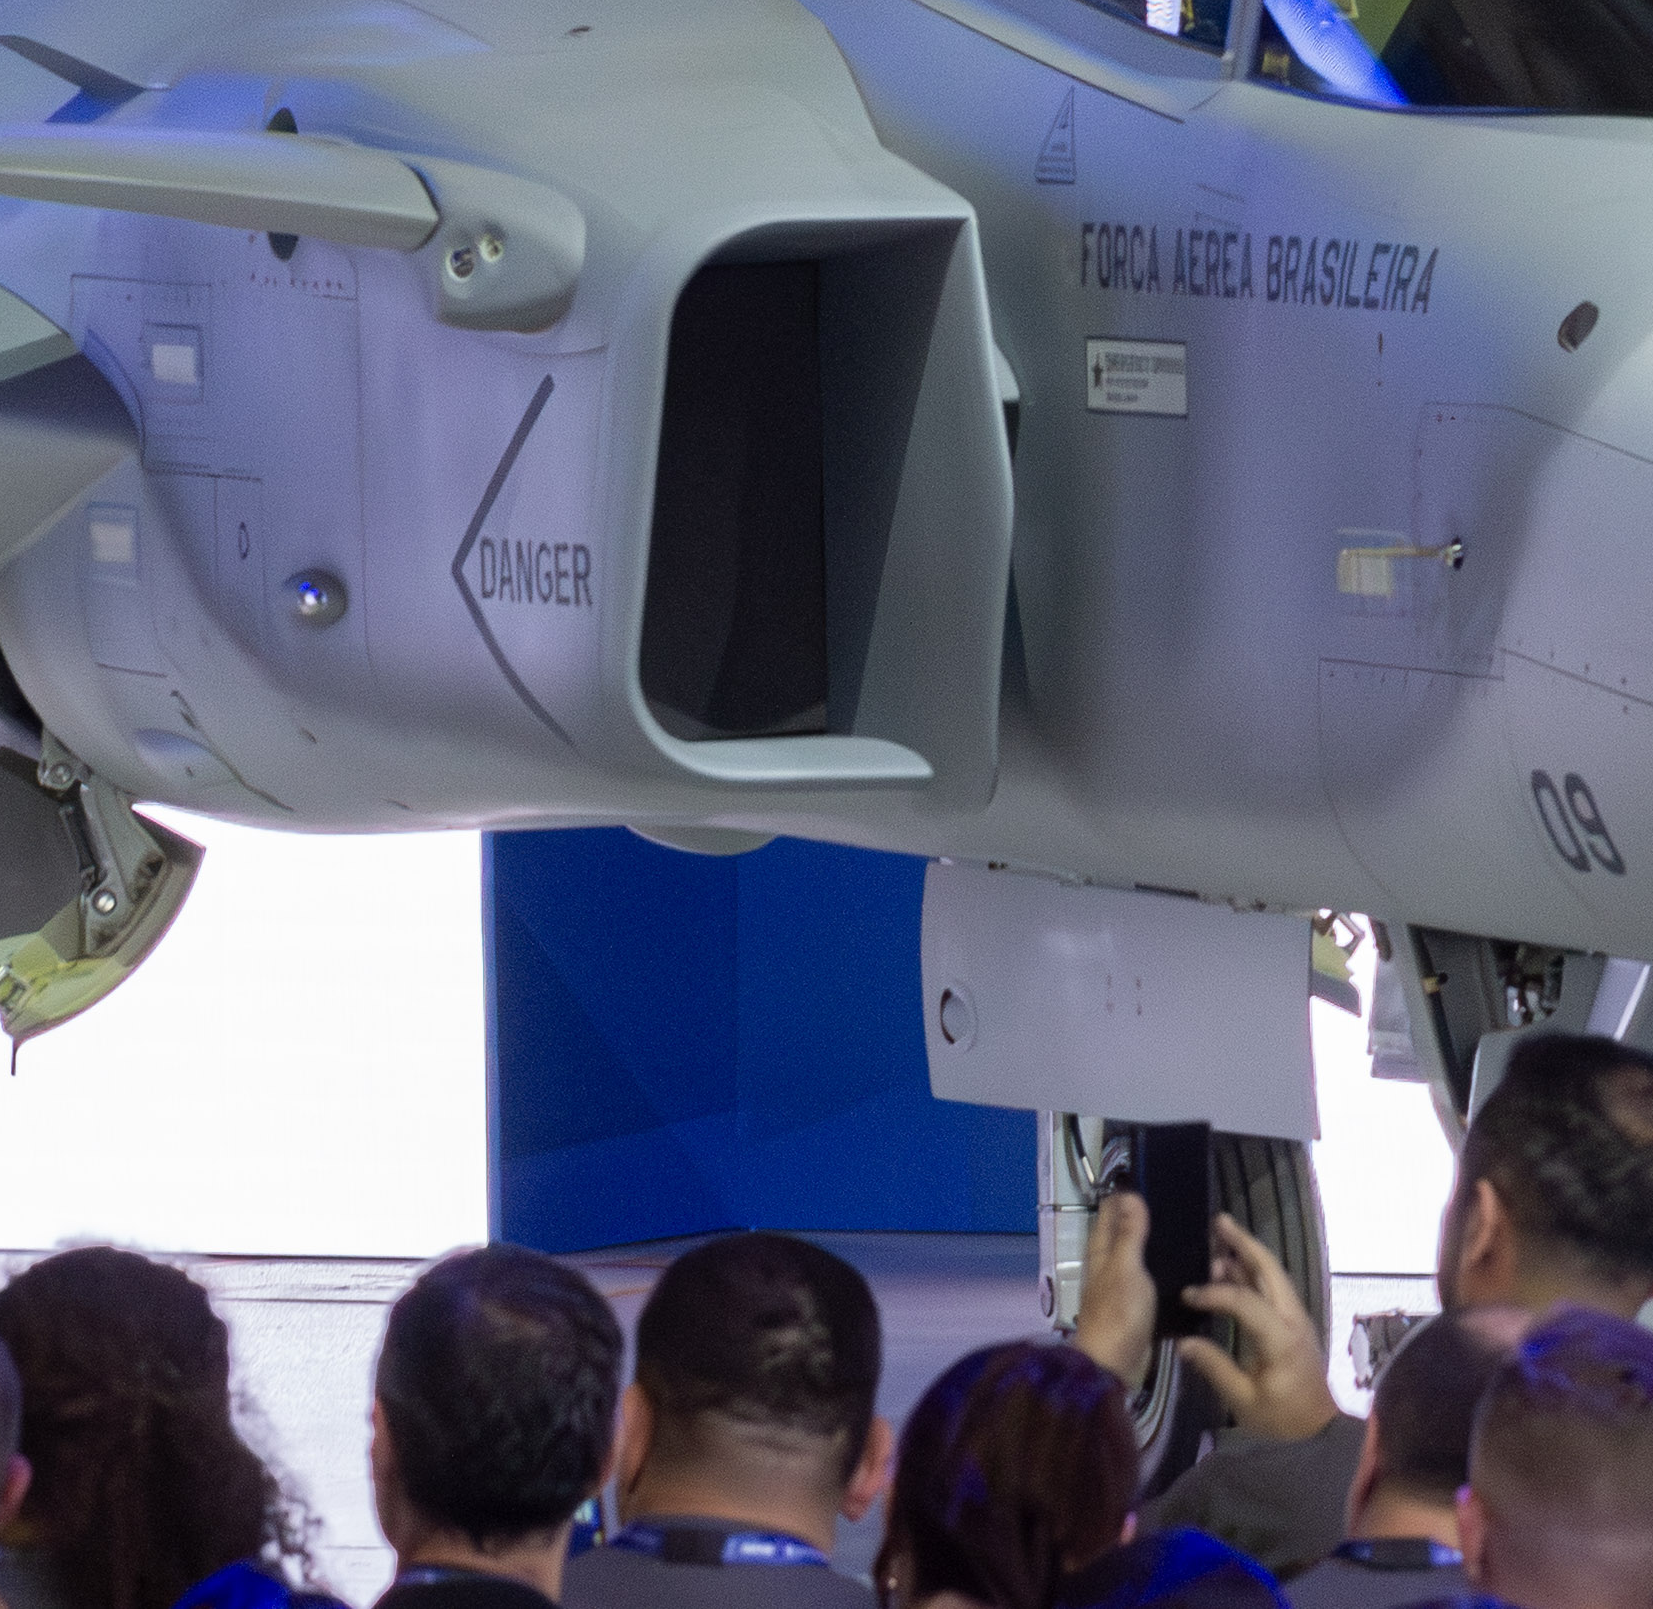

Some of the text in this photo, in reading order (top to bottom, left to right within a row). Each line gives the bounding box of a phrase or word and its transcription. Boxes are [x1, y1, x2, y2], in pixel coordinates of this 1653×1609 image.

[1265, 234, 1440, 314] BRASILEIRA
[479, 535, 594, 606] DANGER
[1530, 768, 1627, 876] 09
